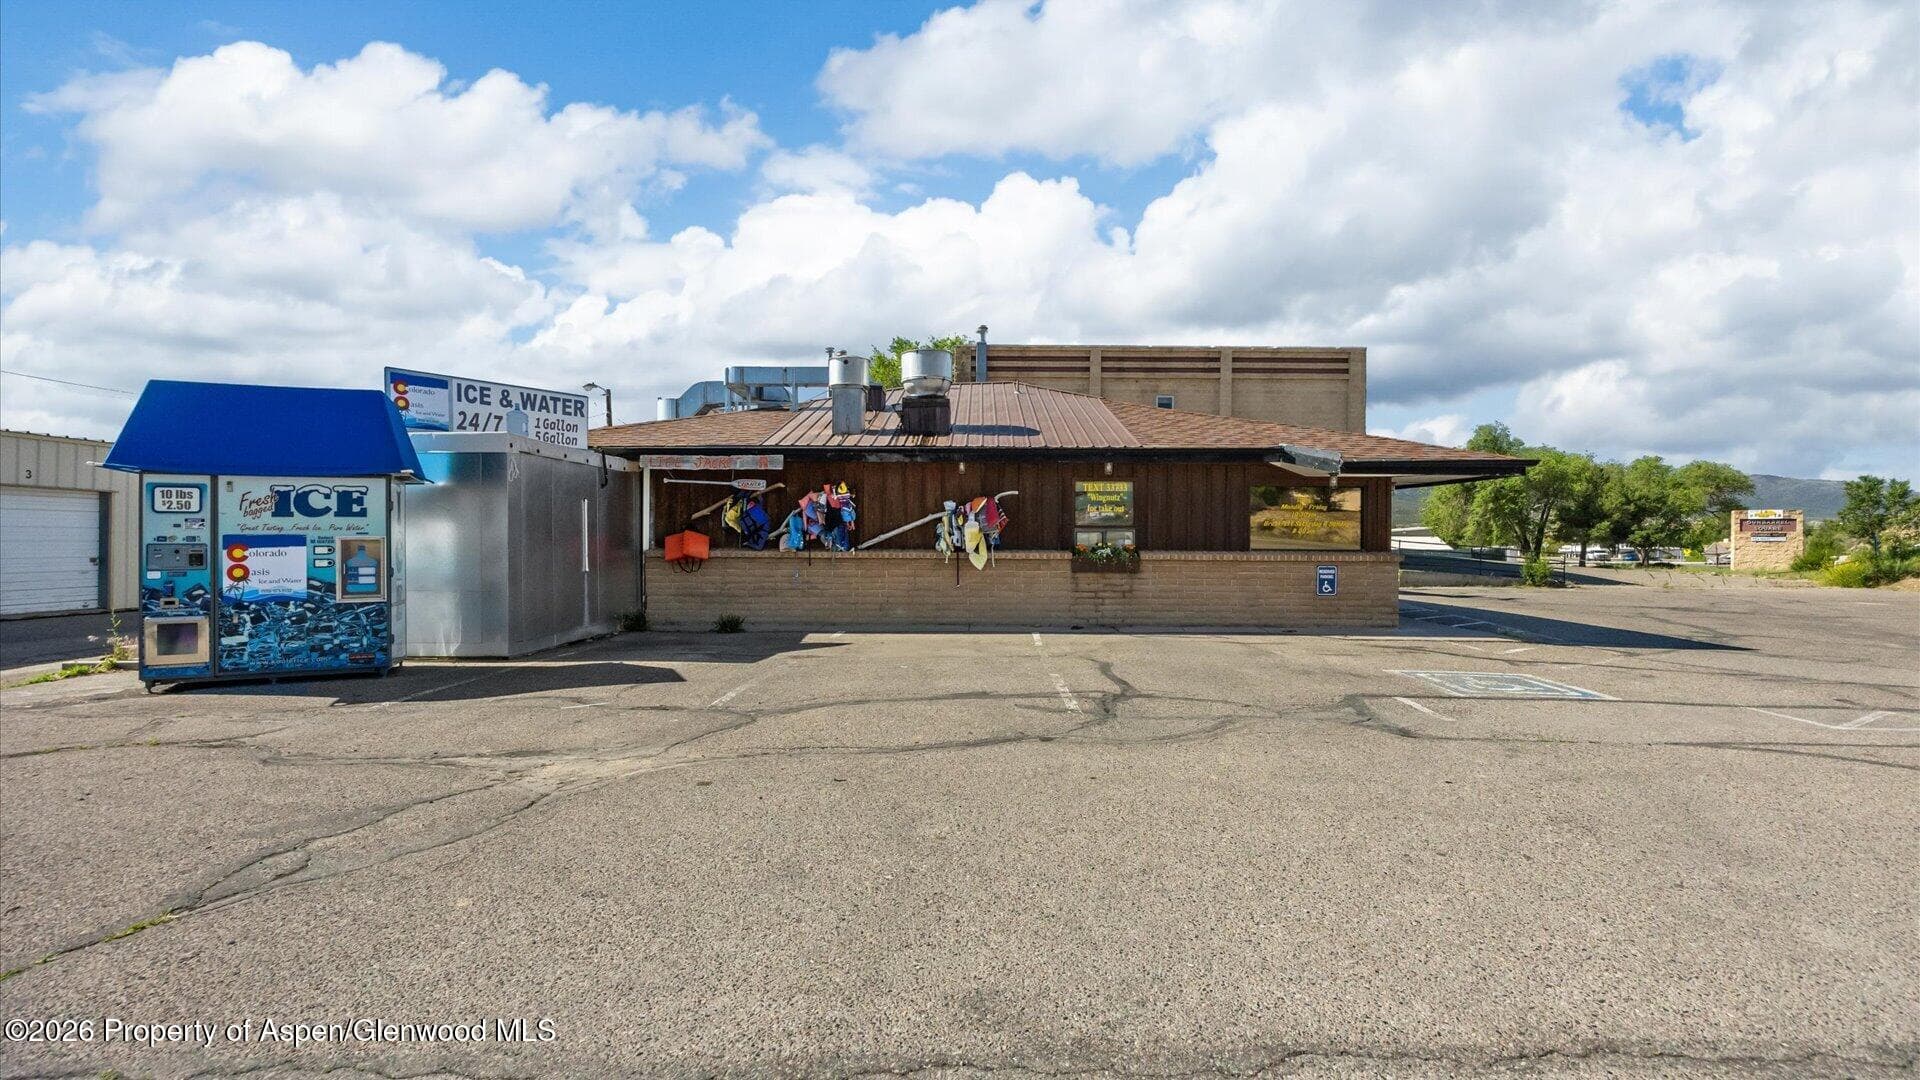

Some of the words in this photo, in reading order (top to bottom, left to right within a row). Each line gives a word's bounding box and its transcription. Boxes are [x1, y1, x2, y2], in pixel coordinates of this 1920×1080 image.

[456, 382, 491, 406] ICE
[500, 389, 514, 408] &
[520, 392, 585, 418] WATER
[456, 411, 504, 432] 24/7
[534, 418, 541, 429] 1
[543, 418, 578, 433] Gallon
[535, 431, 541, 440] 5
[543, 432, 578, 446] Gallon
[25, 470, 32, 479] 3
[160, 489, 173, 500] 10
[175, 489, 194, 500] lbs
[1083, 483, 1103, 492] TEXT
[162, 500, 192, 511] $2.50
[239, 487, 279, 511] Fresh
[270, 484, 369, 518] ICE
[243, 504, 274, 520] bagged
[1087, 504, 1098, 512] for
[226, 544, 287, 562] Colorado
[226, 564, 270, 582] Oasis
